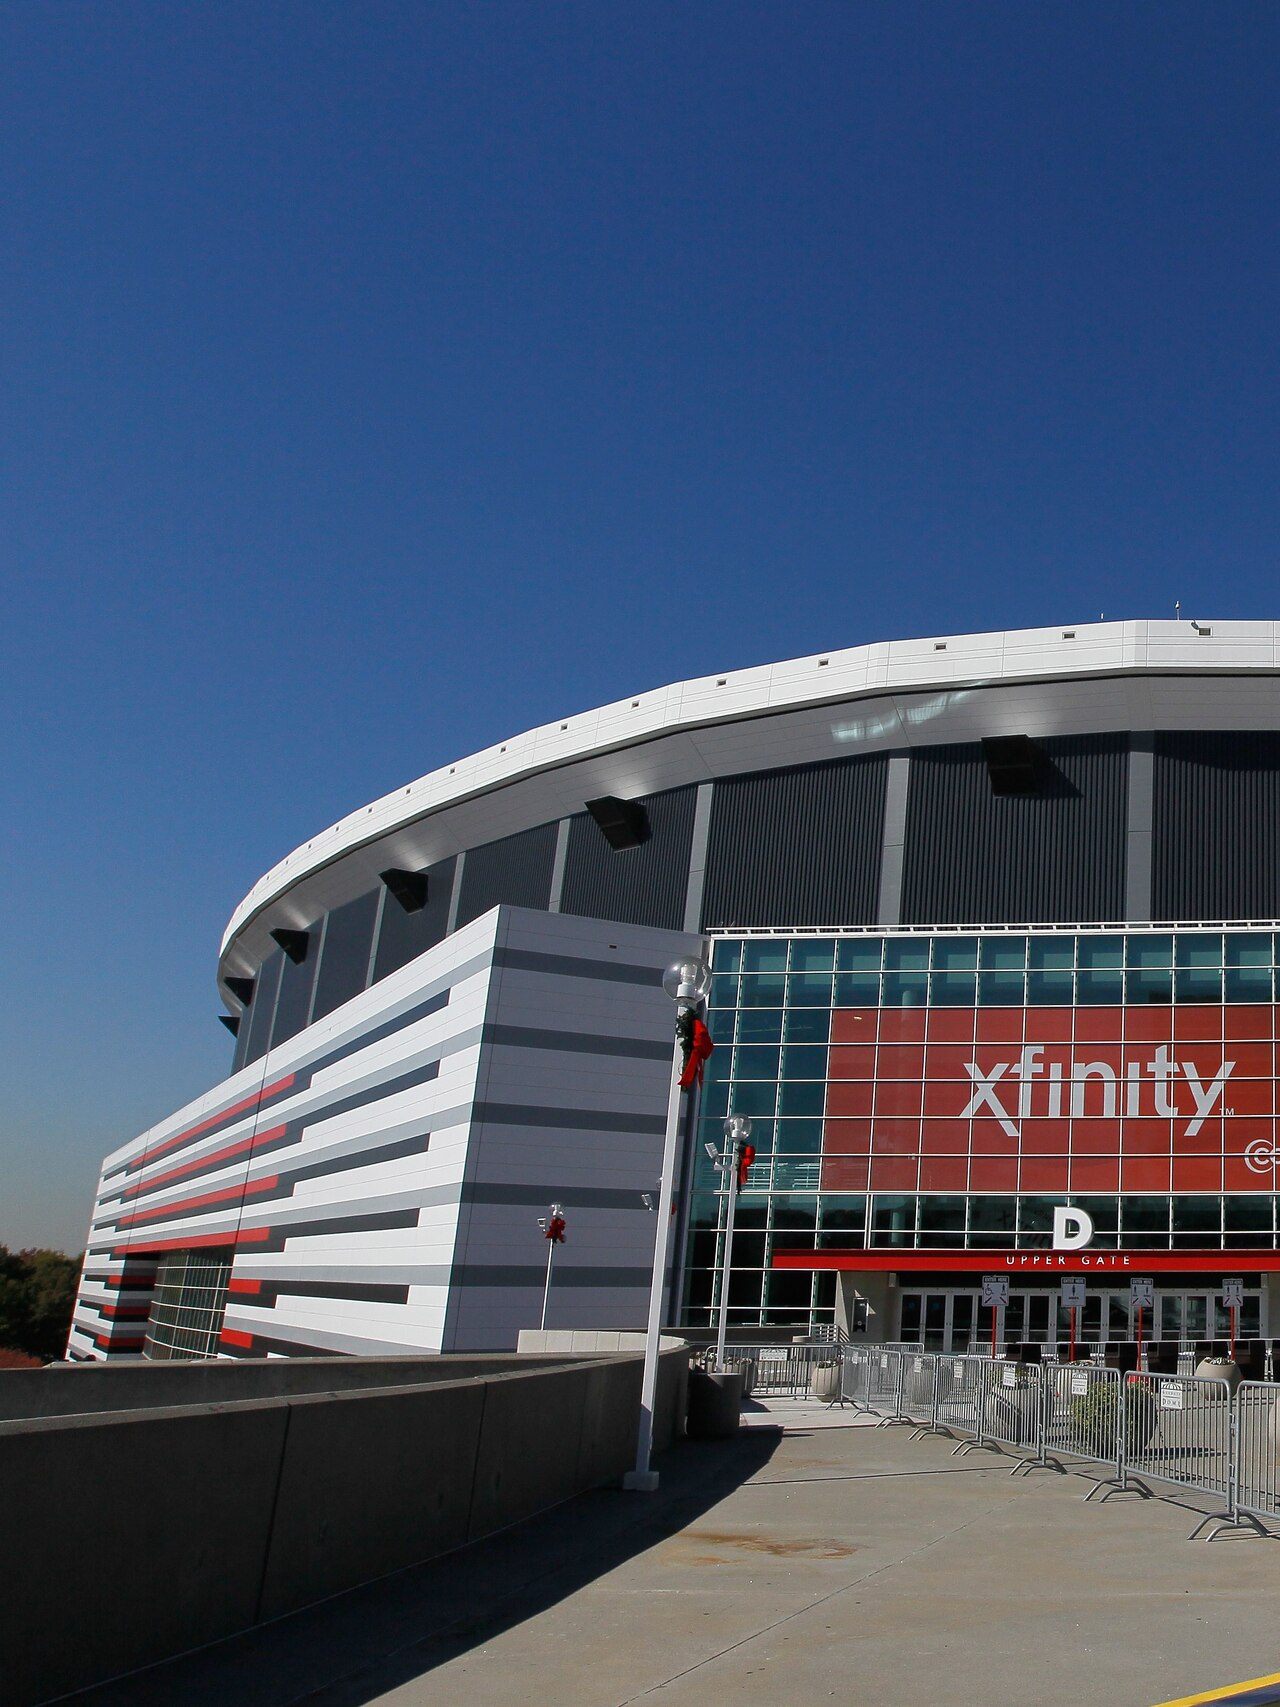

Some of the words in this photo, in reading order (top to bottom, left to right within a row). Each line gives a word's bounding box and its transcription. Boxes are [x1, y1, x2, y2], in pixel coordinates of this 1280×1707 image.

[959, 1045, 1236, 1136] xfinity
[1053, 1206, 1094, 1250] D
[1006, 1256, 1065, 1265] UPPER
[1081, 1256, 1130, 1265] GATE
